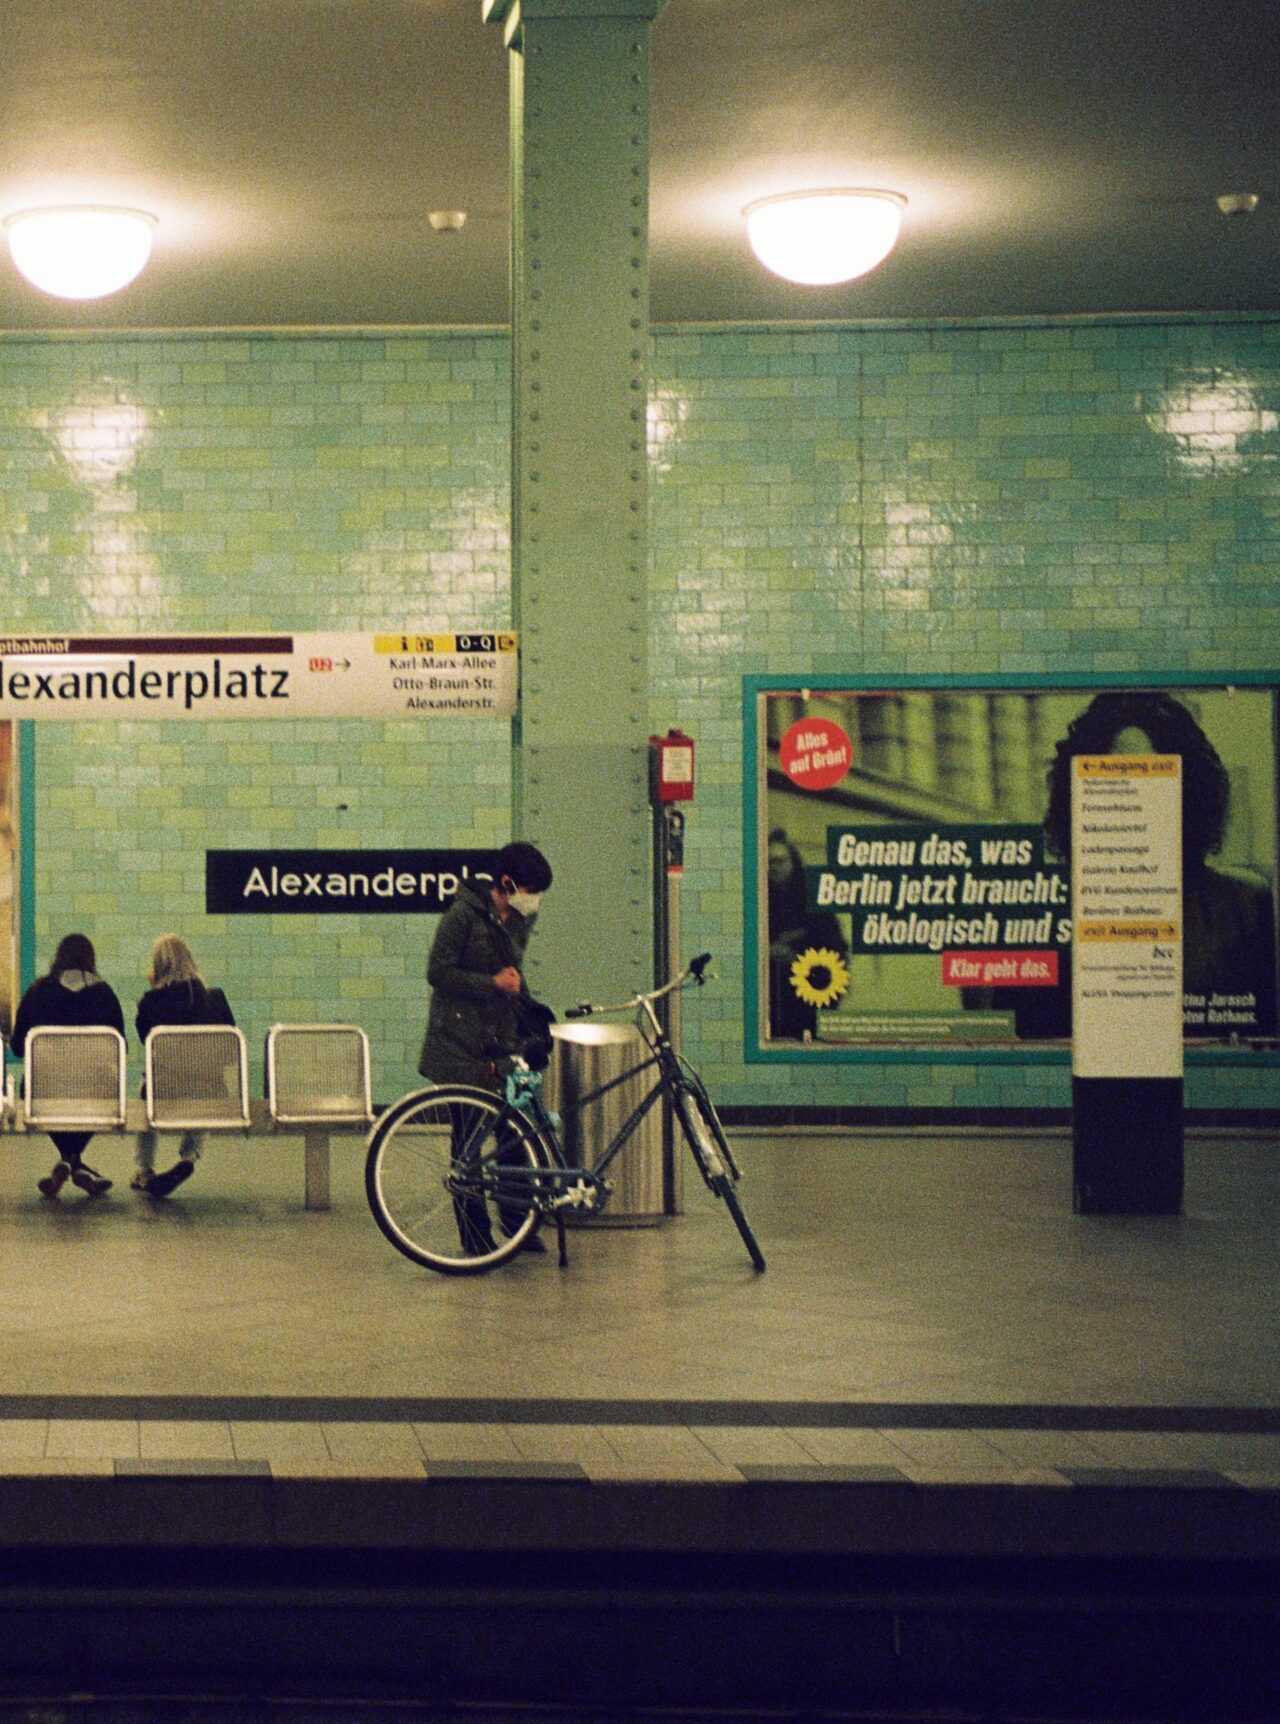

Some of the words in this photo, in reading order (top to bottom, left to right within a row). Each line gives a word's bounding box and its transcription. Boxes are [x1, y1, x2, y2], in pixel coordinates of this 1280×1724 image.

[837, 833, 916, 867] Genau
[919, 833, 973, 869] das,
[980, 839, 1033, 866] was
[243, 865, 493, 902] Alexanderp
[817, 872, 893, 905] Berlin
[894, 873, 957, 911] jetzt
[961, 872, 1068, 905] braucht:
[862, 911, 1000, 951] ökologisch
[1003, 911, 1053, 944] und
[949, 957, 980, 978] Klar
